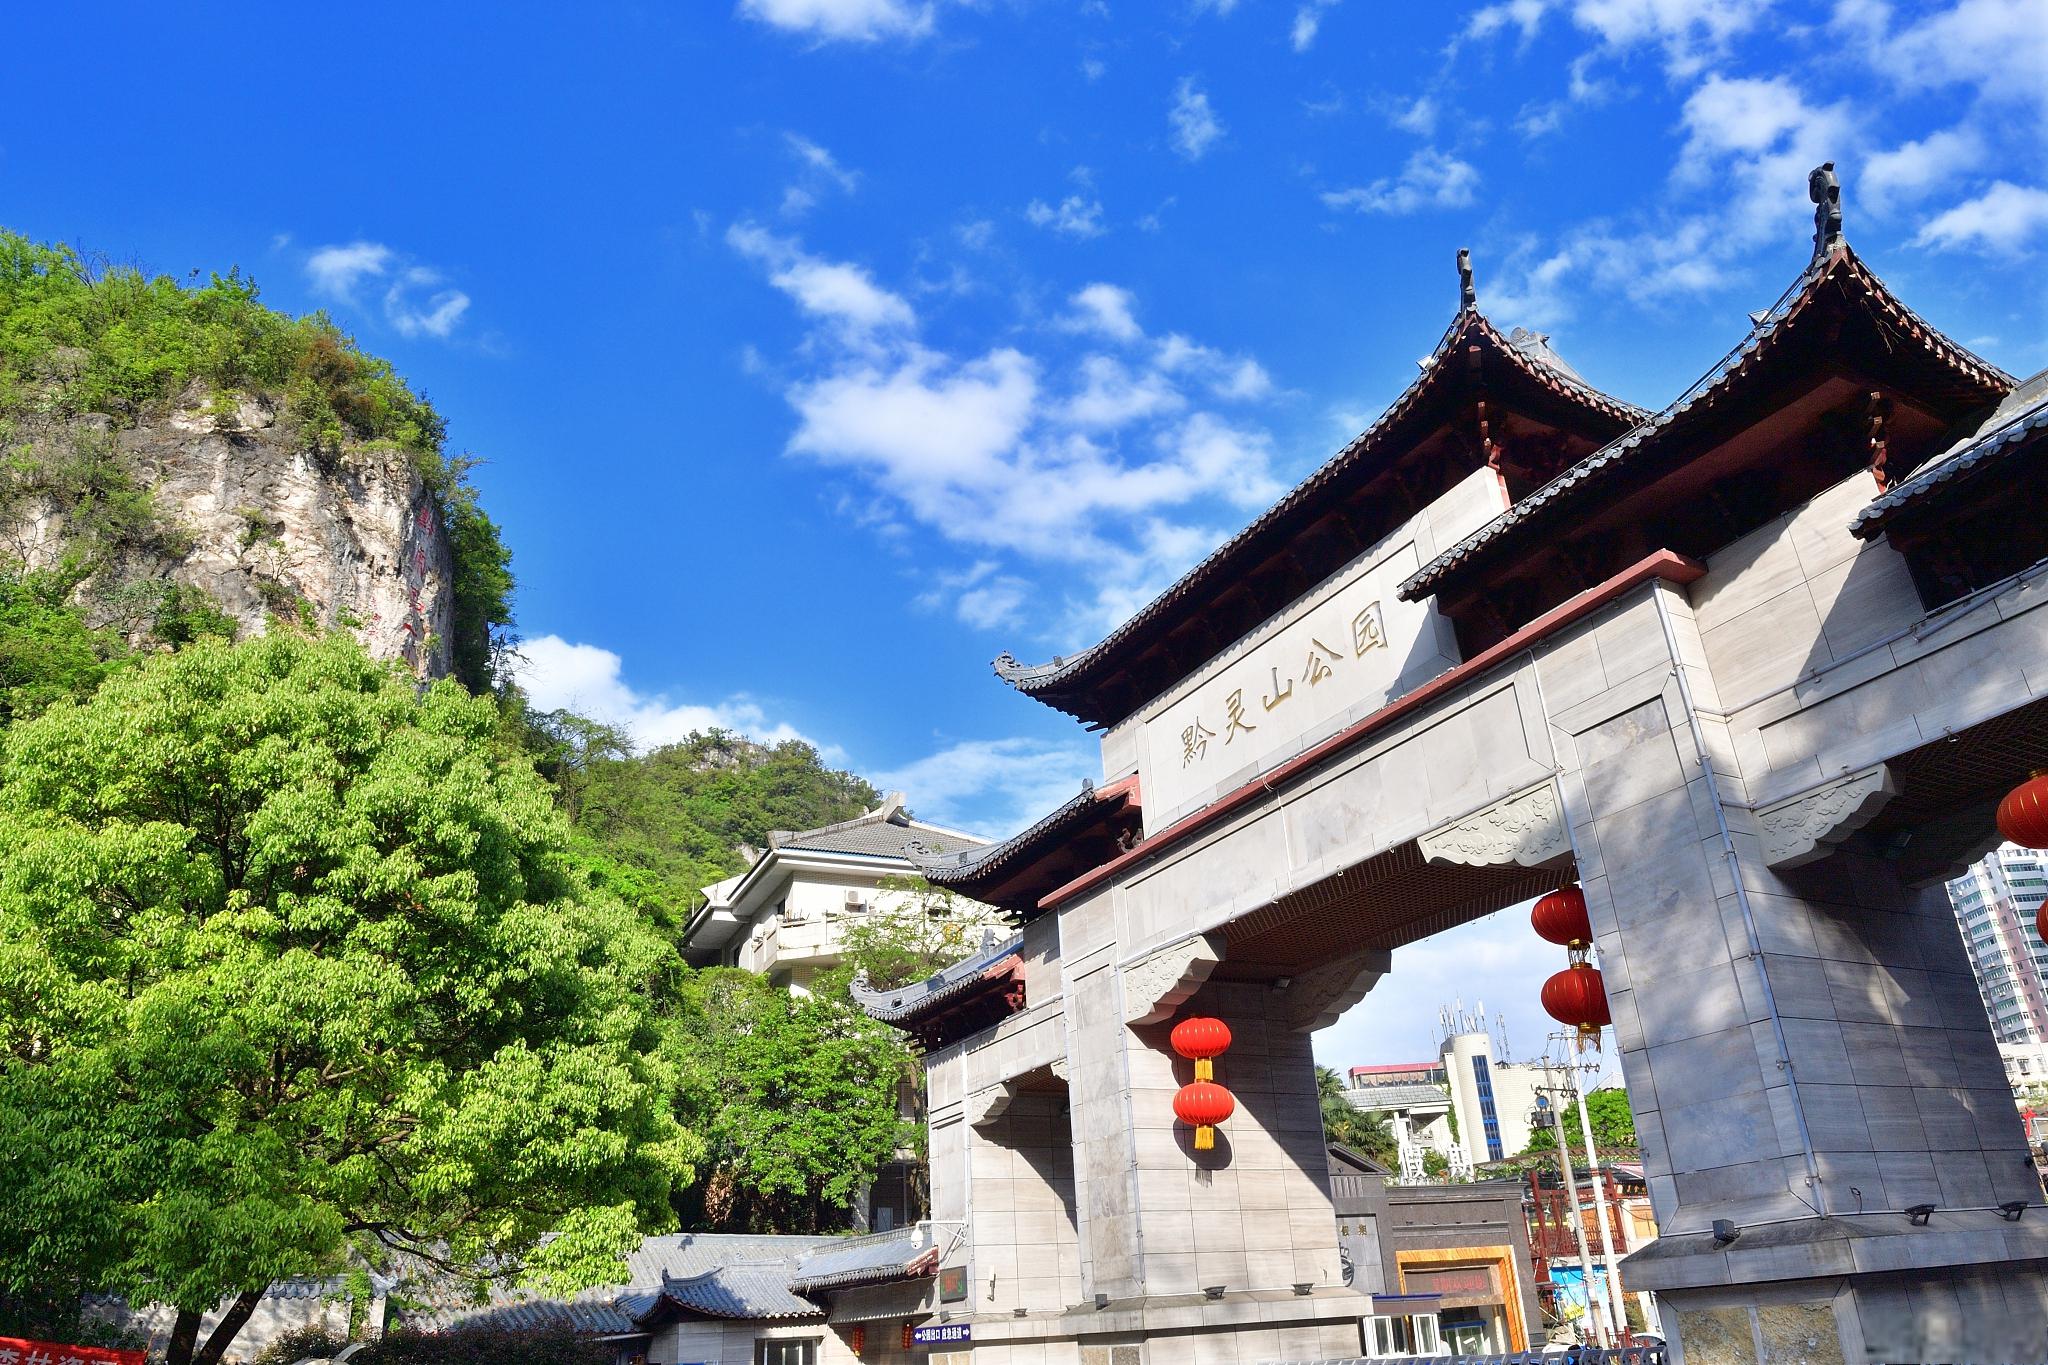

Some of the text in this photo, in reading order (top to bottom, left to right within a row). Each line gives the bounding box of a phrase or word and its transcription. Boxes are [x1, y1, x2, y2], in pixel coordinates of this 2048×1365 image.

[1181, 600, 1388, 769] 黔灵山公园
[1398, 1142, 1474, 1181] 假期
